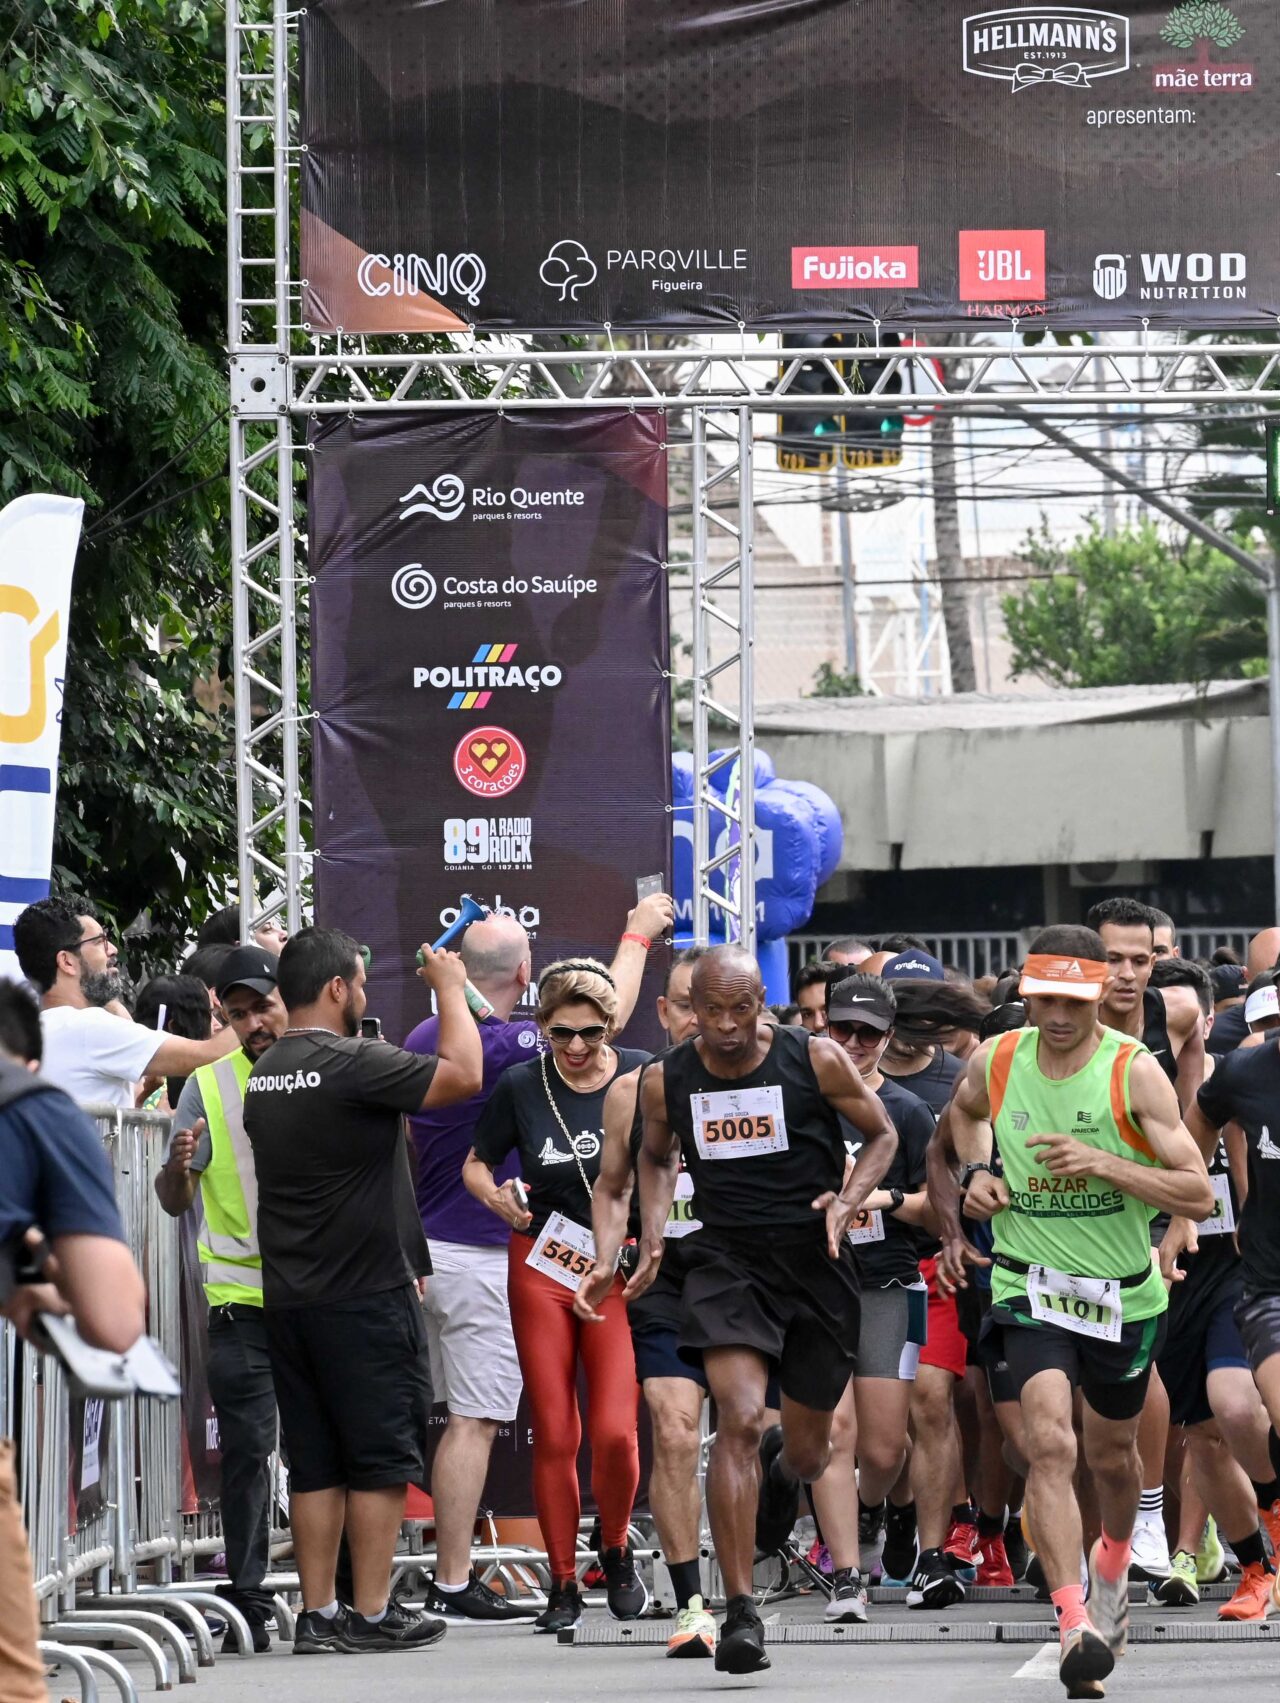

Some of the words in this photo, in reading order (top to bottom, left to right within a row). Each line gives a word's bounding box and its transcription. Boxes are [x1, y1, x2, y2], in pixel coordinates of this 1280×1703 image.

[973, 19, 1118, 54] HELLMANN'S
[1154, 69, 1199, 88] mãe
[1203, 70, 1253, 88] terra
[1086, 106, 1197, 126] apresentam:
[606, 249, 748, 271] PARQVILLE
[803, 255, 907, 281] Fujioka
[978, 250, 1032, 282] JBL
[1139, 252, 1246, 283] WOD
[651, 279, 704, 293] Figueira
[1140, 286, 1247, 300] NUTRITION
[967, 303, 1047, 318] HARMAN
[472, 487, 506, 507] Rio
[510, 487, 585, 509] Quente
[472, 512, 505, 521] parques
[514, 511, 542, 520] resorts
[443, 576, 499, 594] Costa
[502, 575, 529, 594] do
[531, 574, 597, 599] Sauípe
[443, 602, 476, 610] parques
[484, 600, 512, 608] resorts
[413, 665, 562, 693] POLITRAÇO
[459, 765, 474, 775] 3
[467, 761, 520, 792] corações
[489, 817, 498, 836] A
[499, 817, 532, 836] RADIO
[443, 818, 490, 864] 89
[489, 835, 533, 864] ROCK
[245, 1070, 321, 1095] PRODUÇÃO
[706, 1115, 771, 1143] 5005
[1028, 1176, 1089, 1193] BAZAR
[1050, 1188, 1124, 1210] ALCIDES
[1042, 1293, 1104, 1324] 1101
